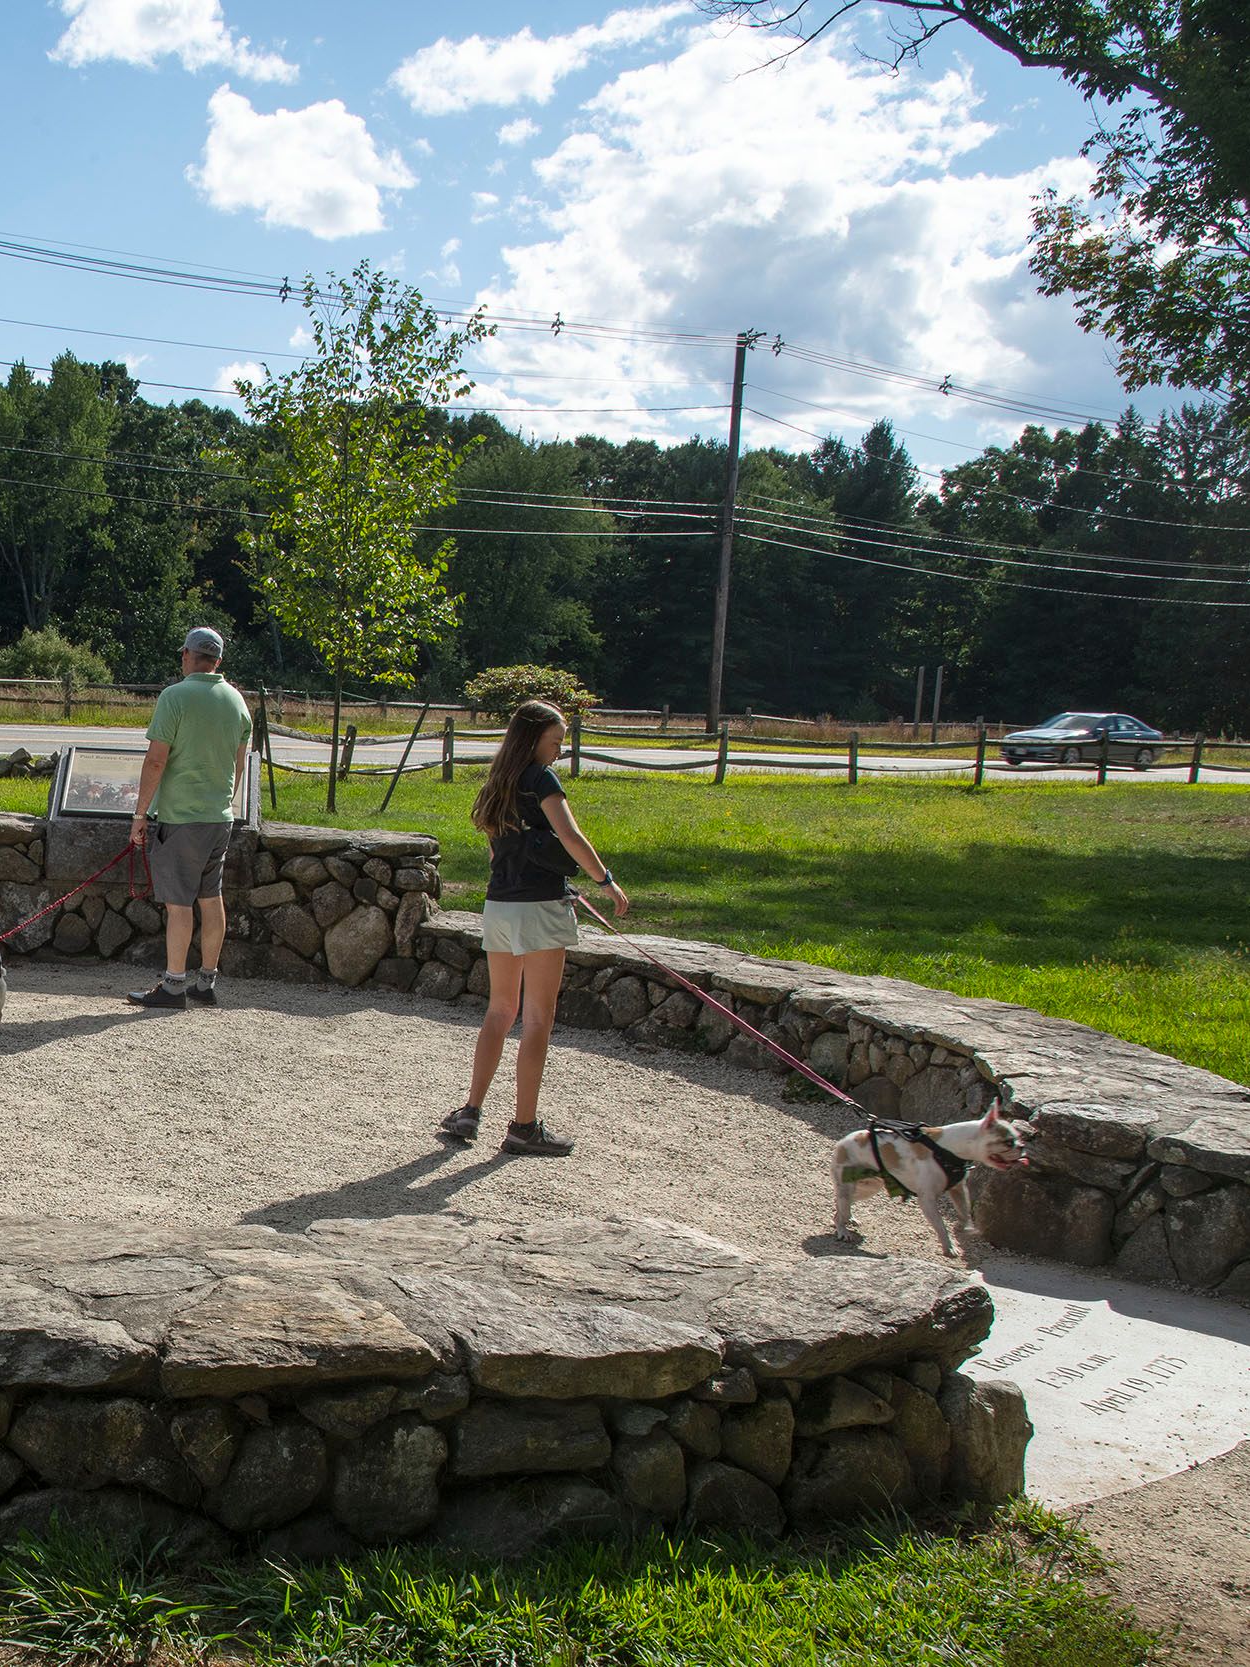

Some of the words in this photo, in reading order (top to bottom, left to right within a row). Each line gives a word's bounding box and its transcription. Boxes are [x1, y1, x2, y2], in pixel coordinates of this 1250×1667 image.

[972, 1342, 1042, 1372] Revere
[1037, 1303, 1092, 1339] Prescott
[1035, 1366, 1085, 1389] 1:30
[1076, 1353, 1117, 1371] a.m.
[1079, 1387, 1138, 1416] April
[1142, 1354, 1188, 1379] 1775
